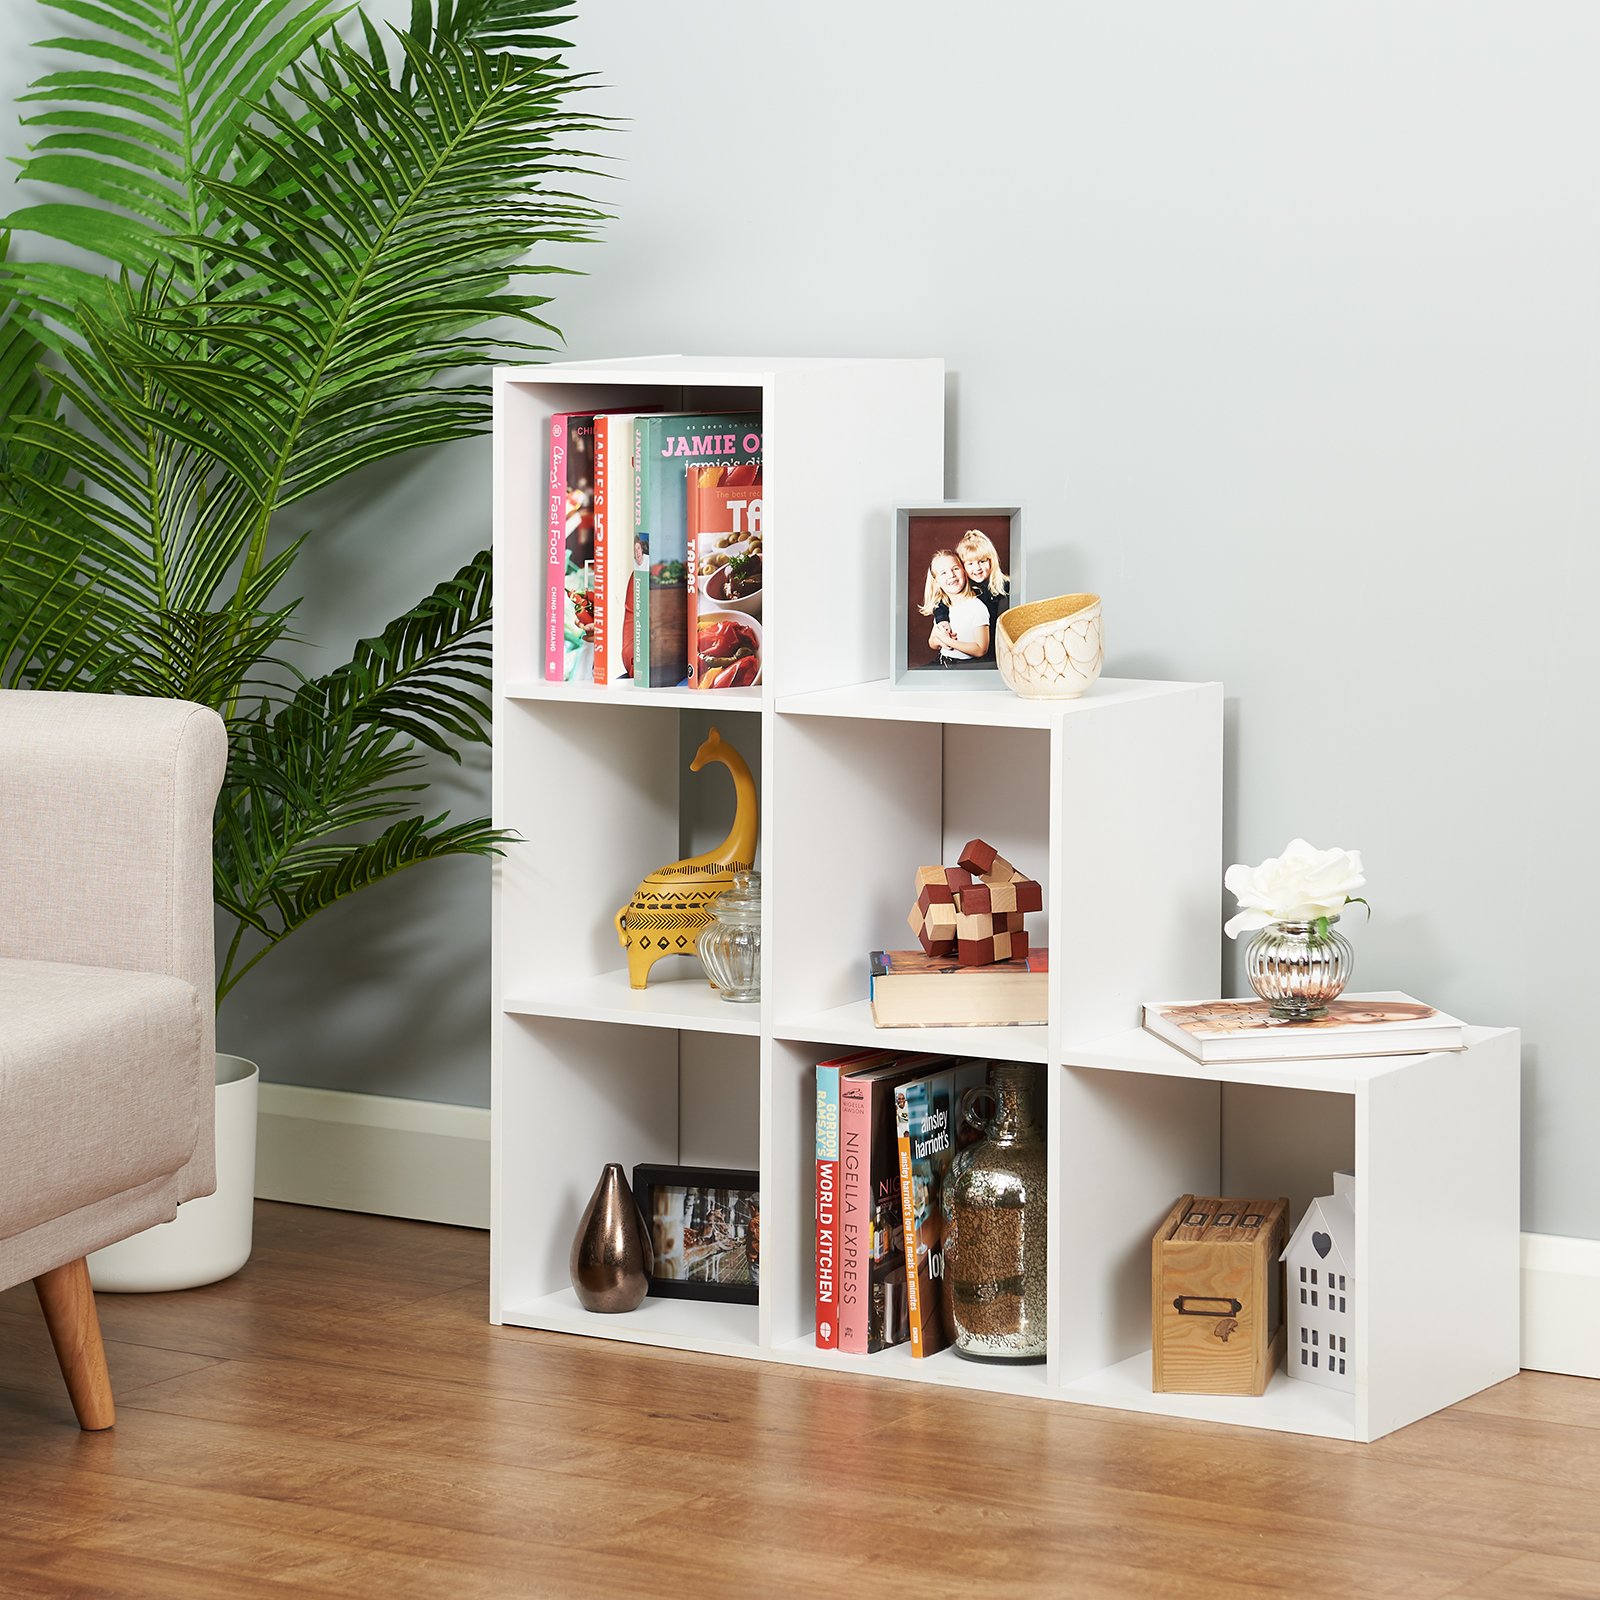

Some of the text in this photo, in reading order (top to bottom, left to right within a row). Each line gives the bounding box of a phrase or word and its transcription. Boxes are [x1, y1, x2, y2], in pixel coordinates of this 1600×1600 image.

[550, 445, 564, 490] Ching's
[661, 432, 763, 457] JAMIE O
[550, 495, 561, 526] Fast
[715, 490, 763, 499] The best rec
[549, 529, 560, 564] Food
[687, 539, 696, 594] TAPAS
[594, 546, 604, 601] MINUTE
[594, 606, 604, 653] MEALS
[817, 1090, 827, 1157] RAMSAY'S
[825, 1103, 837, 1158] GORDON
[915, 1130, 950, 1159] harriott's
[921, 1108, 948, 1134] ainsley
[819, 1163, 833, 1303] WORLD KITCHEN
[843, 1132, 859, 1305] NIGELLA EXPRESS
[900, 1151, 918, 1311] ainsley harriott's low fat meals in minutes
